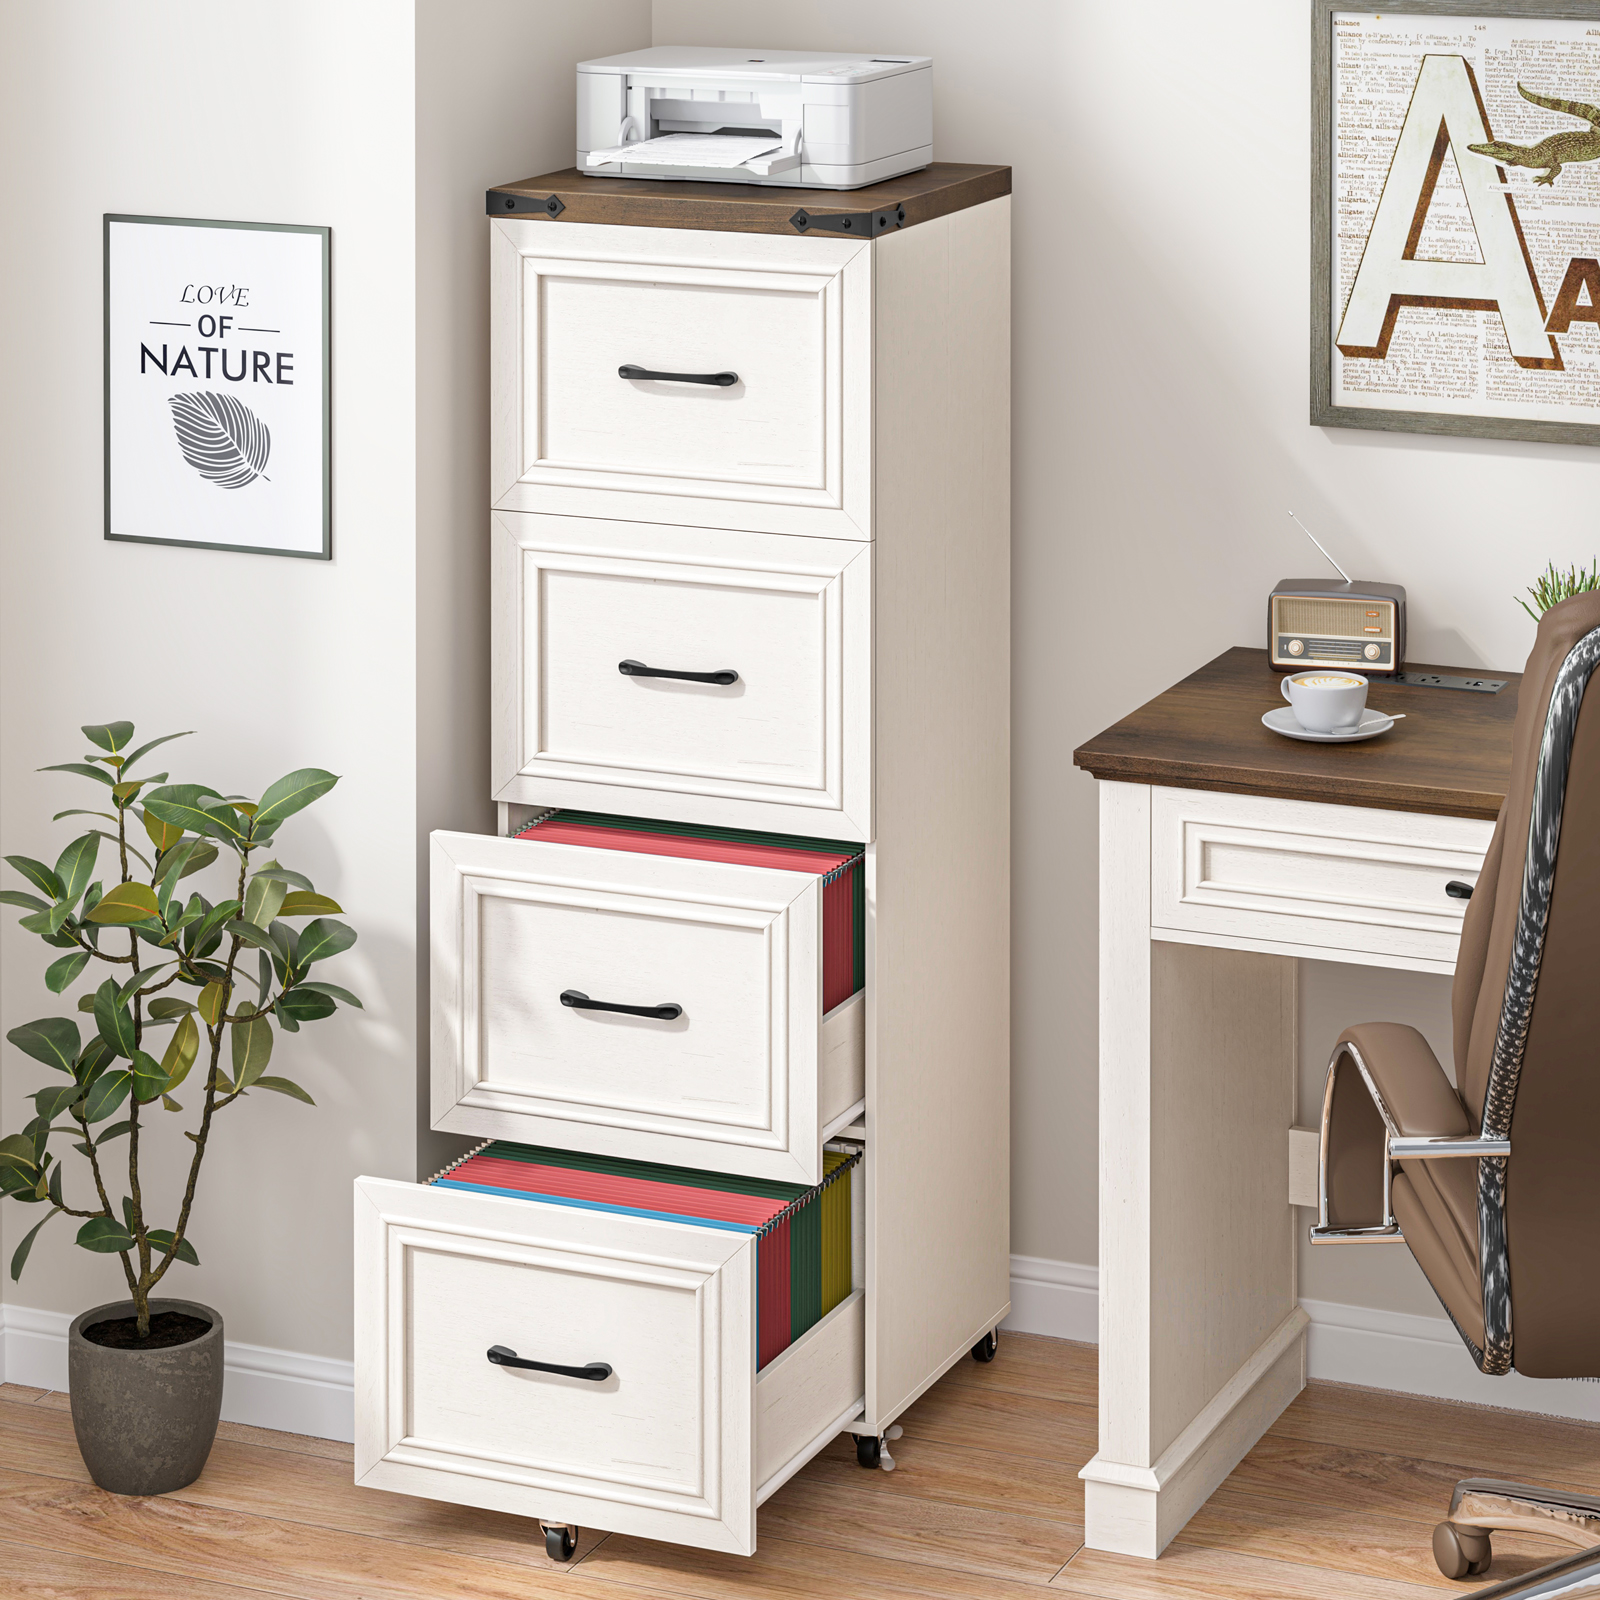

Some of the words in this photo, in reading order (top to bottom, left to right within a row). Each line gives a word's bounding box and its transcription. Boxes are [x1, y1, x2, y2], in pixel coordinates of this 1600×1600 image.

[179, 284, 250, 308] LOVE
[197, 314, 234, 339] OF
[140, 341, 294, 386] NATURE
[1482, 354, 1512, 363] Alligator
